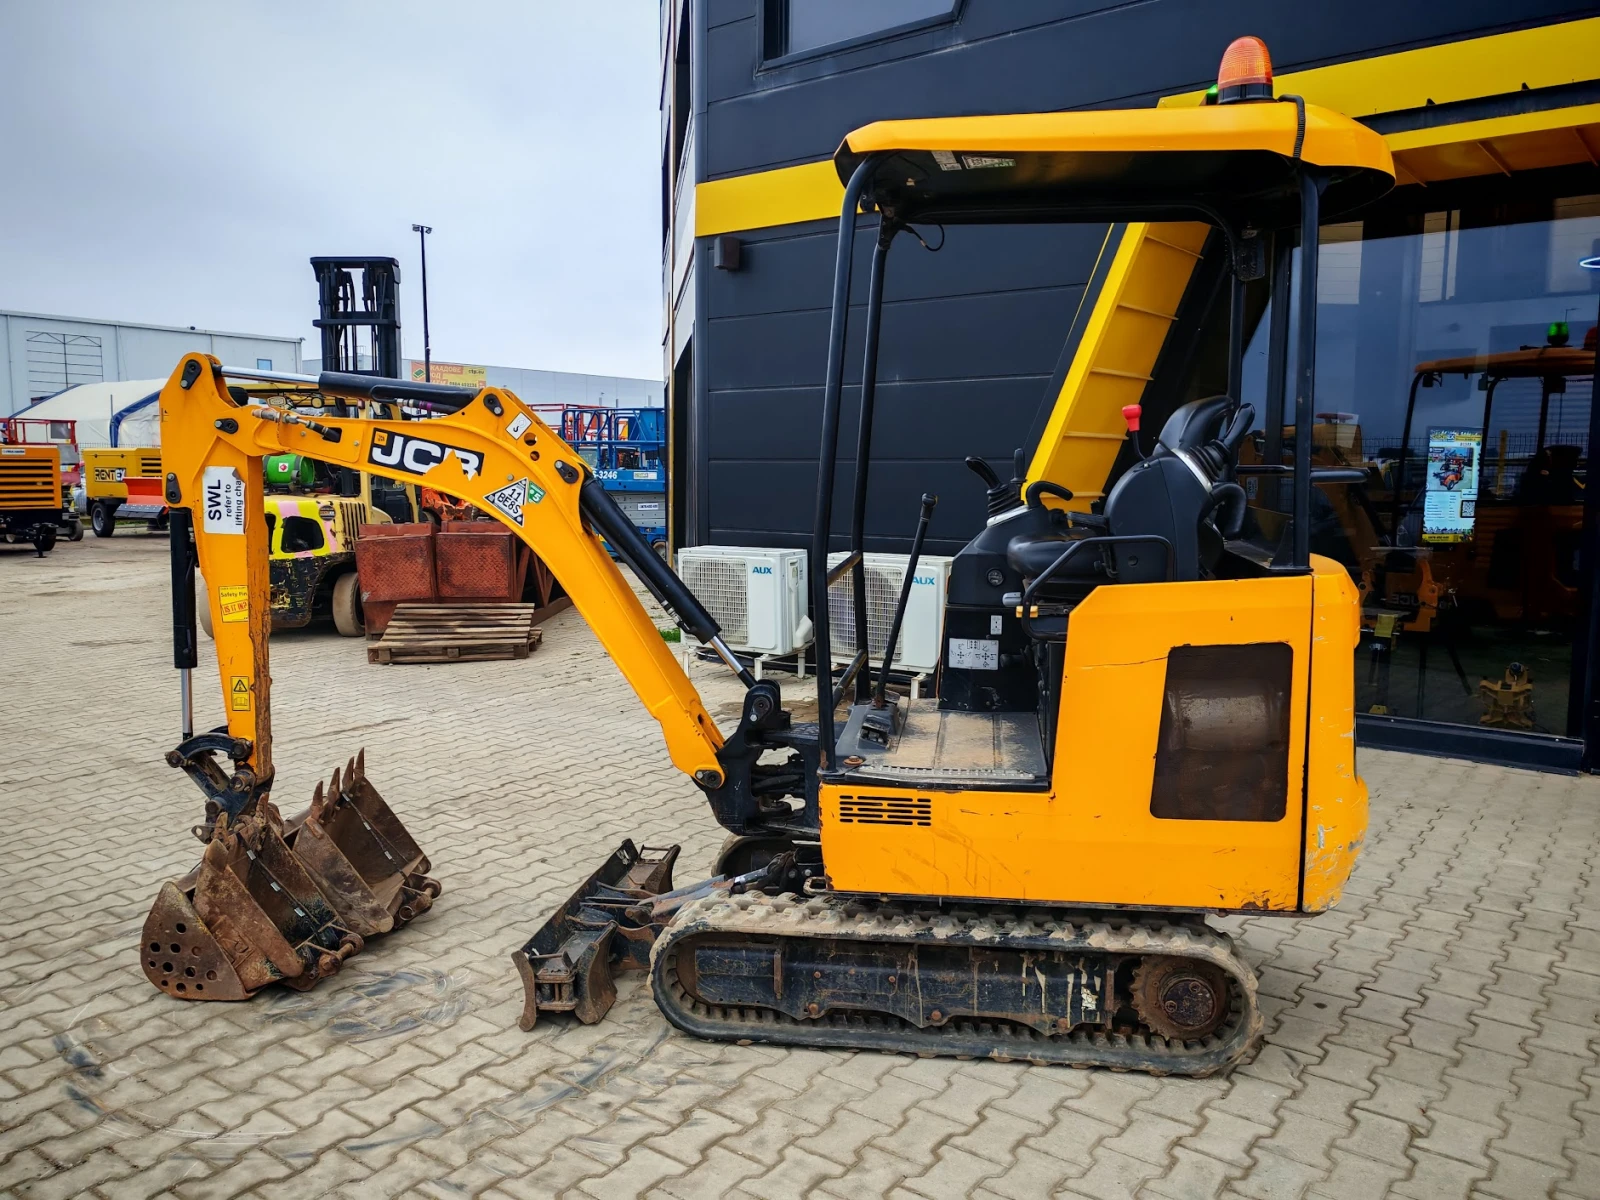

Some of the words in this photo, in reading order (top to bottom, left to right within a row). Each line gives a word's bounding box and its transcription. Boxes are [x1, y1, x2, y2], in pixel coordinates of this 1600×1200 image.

[95, 468, 125, 482] RENTEX
[224, 484, 231, 493] to
[207, 479, 222, 521] SWL
[224, 495, 232, 517] refer
[235, 499, 243, 526] lifting
[752, 566, 773, 575] AUX
[912, 576, 935, 586] AUX
